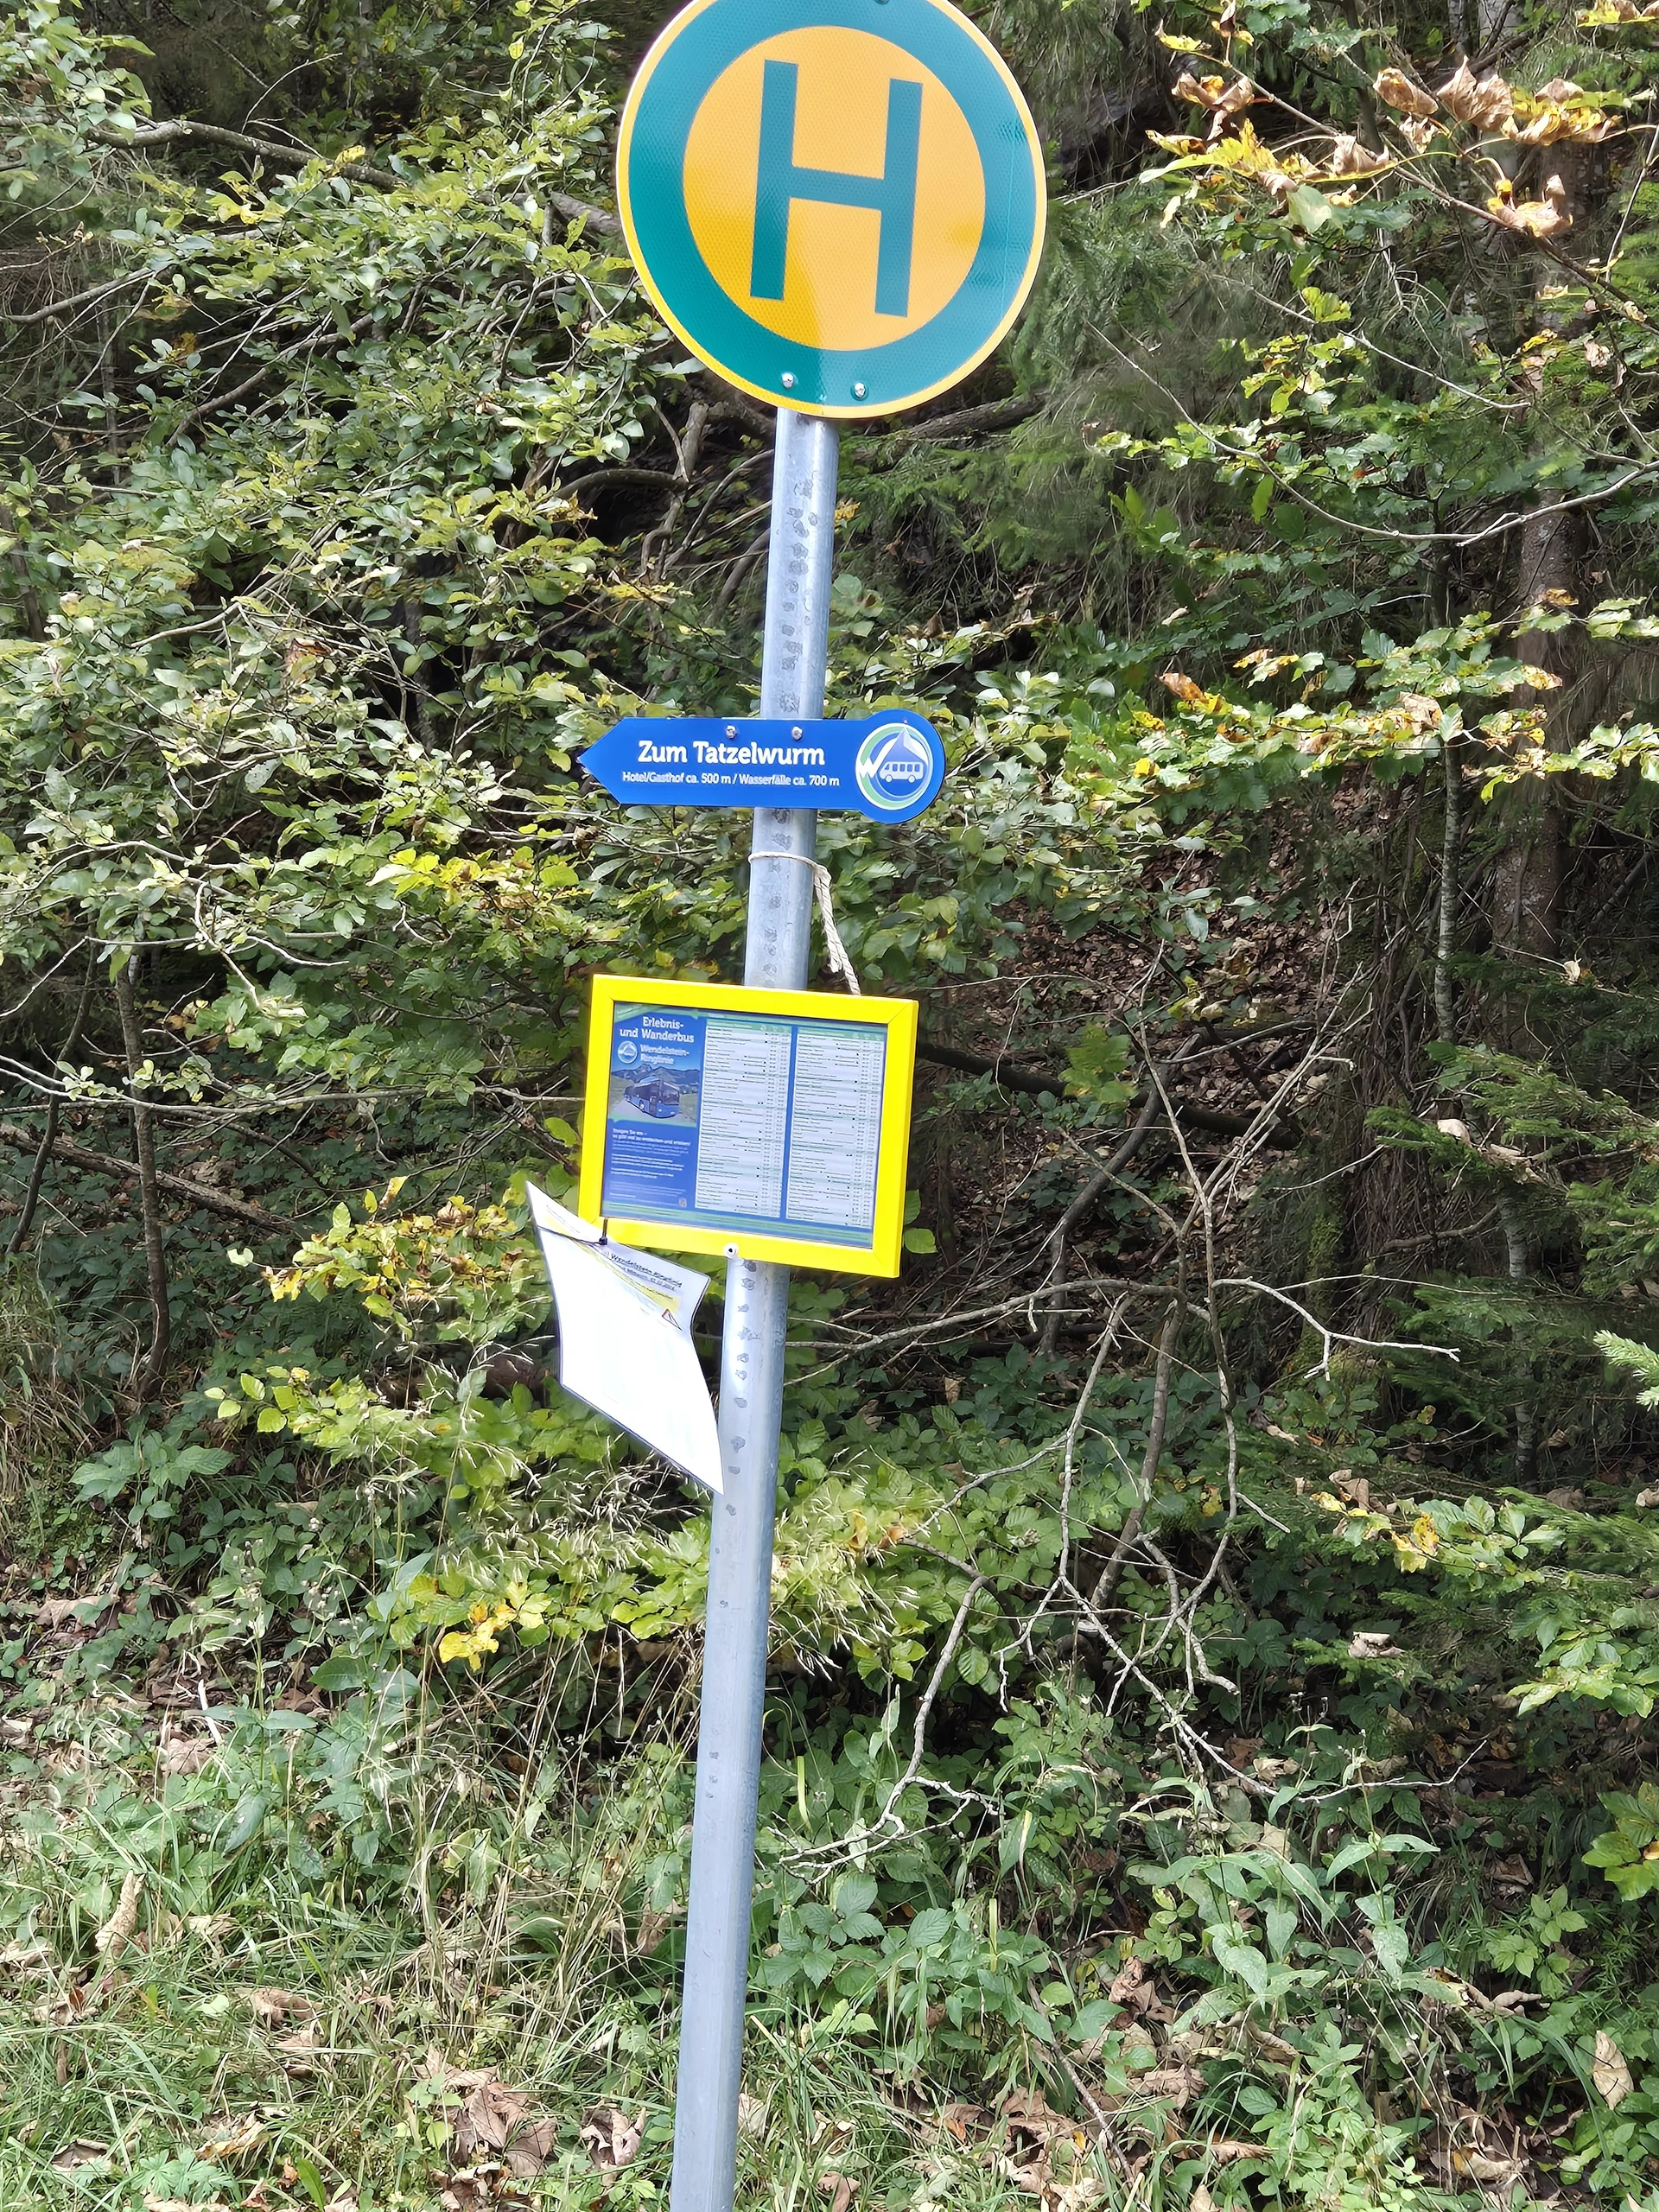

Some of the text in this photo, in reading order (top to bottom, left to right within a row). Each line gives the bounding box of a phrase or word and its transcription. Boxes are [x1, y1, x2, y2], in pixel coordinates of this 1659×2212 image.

[750, 59, 923, 317] H
[638, 740, 825, 766] Zum Tatzelwurm
[622, 771, 685, 784] Hotel/Gasthof
[685, 774, 699, 784] ca.
[701, 773, 719, 785] 500
[721, 775, 731, 785] m
[739, 773, 791, 785] Wasserfälle
[792, 776, 806, 786] ca.
[809, 775, 828, 786] 700
[830, 777, 840, 787] m
[642, 1016, 684, 1030] Erlebnis-
[620, 1028, 695, 1043] und Wanderbus
